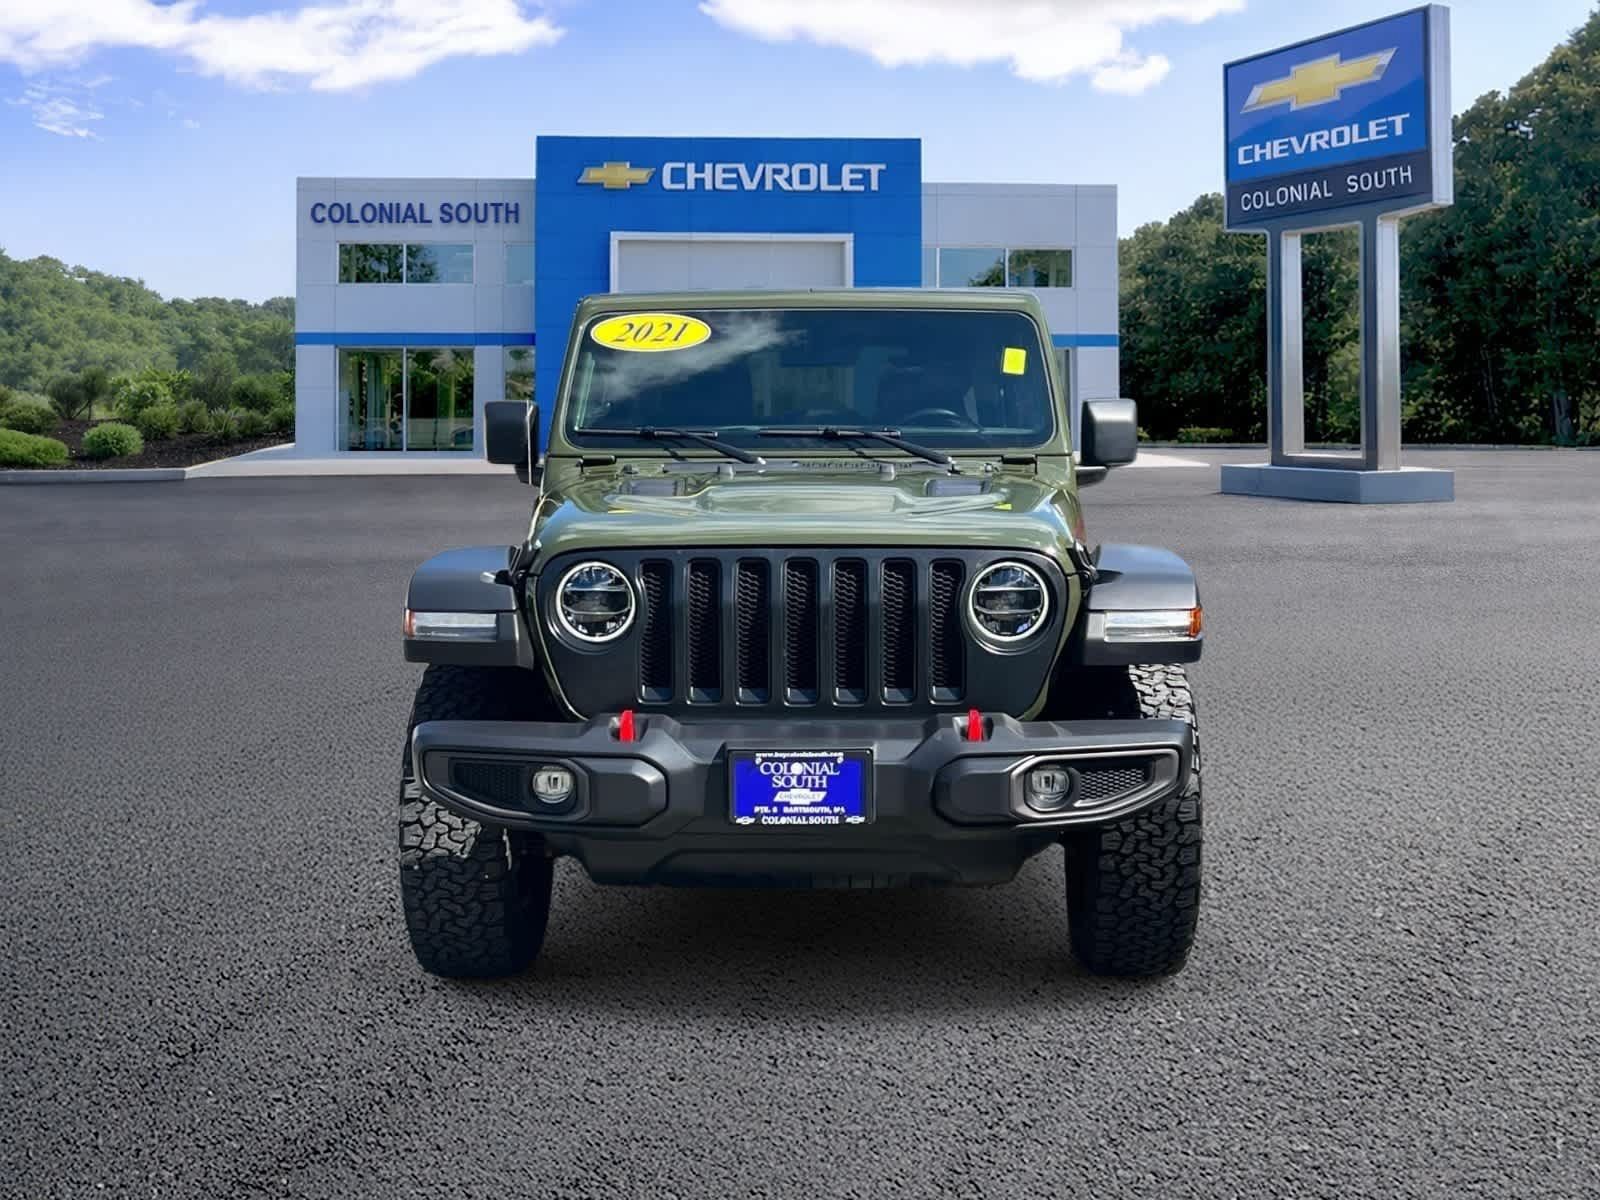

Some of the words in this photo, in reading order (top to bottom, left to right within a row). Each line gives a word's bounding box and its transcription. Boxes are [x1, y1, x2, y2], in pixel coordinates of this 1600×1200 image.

[1237, 113, 1410, 165] CHEVROLET
[662, 161, 887, 191] CHEVROLET
[1240, 180, 1333, 211] COLONIAL
[1346, 165, 1412, 194] SOUTH
[310, 202, 432, 224] COLONIAL
[439, 202, 520, 224] SOUTH
[611, 321, 688, 342] 2021
[760, 762, 840, 775] COLONIAL
[772, 775, 828, 788] SOUTH
[761, 815, 808, 824] COLONIAL
[808, 815, 839, 824] SOUTH
